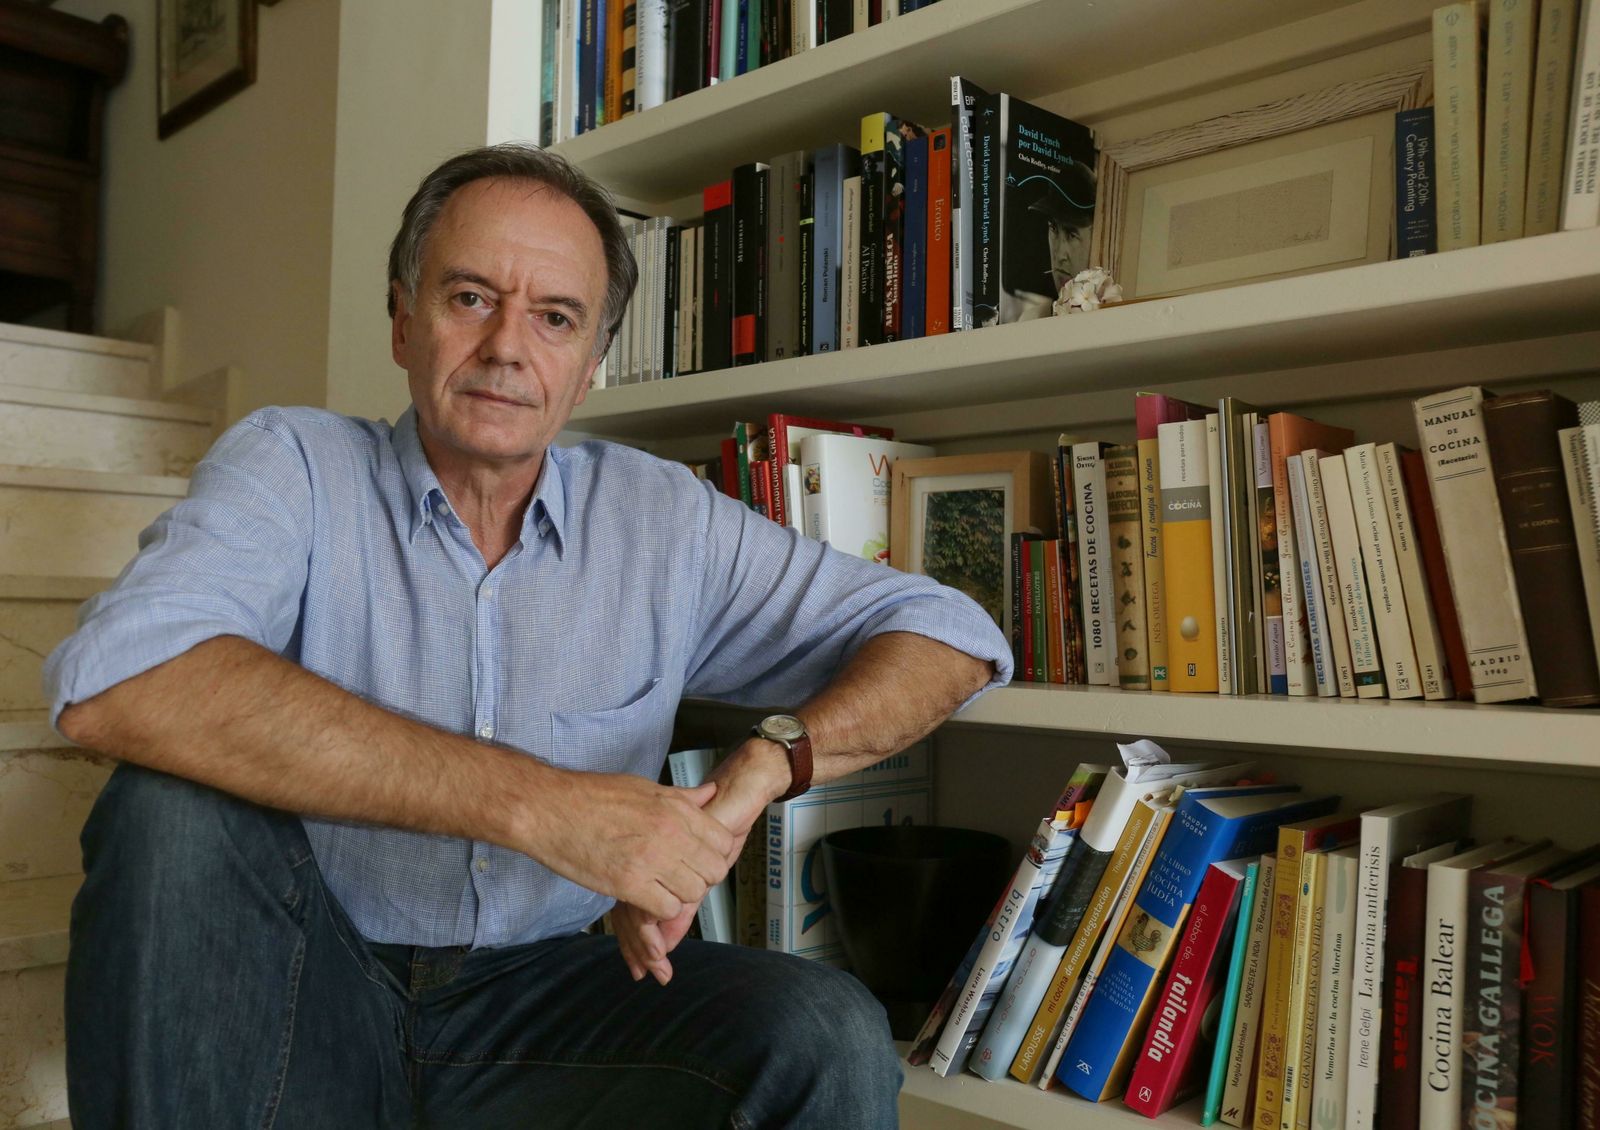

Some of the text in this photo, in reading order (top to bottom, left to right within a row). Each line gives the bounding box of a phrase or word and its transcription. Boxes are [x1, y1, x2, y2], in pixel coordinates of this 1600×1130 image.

[1584, 71, 1596, 91] LOS
[1583, 96, 1592, 107] DE
[983, 135, 991, 156] David
[1018, 124, 1060, 149] David Lynch
[1577, 113, 1590, 147] SOCIAL
[1018, 139, 1074, 165] por David Lynch
[1018, 153, 1030, 163] Chris
[981, 158, 991, 181] Lynch
[1403, 133, 1417, 212] Century Painting
[1417, 160, 1429, 180] and
[1572, 151, 1586, 195] HISTORIA
[1586, 148, 1600, 194] PINTORES
[981, 183, 990, 195] por
[983, 198, 991, 219] David
[1449, 199, 1462, 240] HISTORIA
[981, 221, 991, 244] Lynch
[822, 247, 830, 303] Roman Polanski
[861, 245, 870, 294] Al Pacino
[869, 242, 877, 289] Conversaciones
[884, 233, 894, 287] MUÑECA
[1424, 408, 1477, 427] MANUAL
[768, 427, 777, 455] CHECA
[1429, 436, 1481, 454] COCINA
[1308, 455, 1317, 479] Simone
[1438, 452, 1478, 467] (Recetario)
[772, 456, 781, 512] TRADICIONAL
[1144, 457, 1158, 524] consejos de cocina
[1312, 478, 1321, 499] Ortega
[1168, 500, 1202, 511] COCINA
[1386, 465, 1408, 552] Ortega El libro de las carnes
[1319, 518, 1327, 540] Ortega
[1322, 541, 1329, 549] El
[1362, 471, 1391, 614] Victoria Llamas Cocina para personas ocupadas
[1083, 482, 1103, 649] 1080 RECETAS DE COCINA
[1323, 549, 1331, 565] libro
[1326, 565, 1332, 574] de
[1151, 580, 1161, 644] INÉS ORTEGA
[1327, 584, 1337, 606] potajes
[1272, 623, 1280, 645] Zapata
[1287, 620, 1295, 649] Cocina
[1303, 560, 1326, 685] RECETAS ALMERIENSES
[1345, 583, 1362, 654] 7207 Lourdes March
[1359, 606, 1372, 659] libro paella
[1059, 785, 1075, 808] COME
[1180, 809, 1208, 832] CLAUDIA
[1181, 819, 1203, 838] RODEN
[769, 815, 782, 890] CEVICHE
[1159, 850, 1193, 877] EL LIBRO
[1150, 869, 1185, 899] COCINA
[1159, 864, 1181, 883] DE LA
[1146, 882, 1175, 908] JUDÍA
[991, 888, 1025, 943] bistro
[1178, 904, 1209, 968] el sabor de...
[1019, 849, 1128, 1072] LAROUSSE mi cocina de menús degustación Thierry
[1357, 845, 1381, 1069] Irene Gelpí La cocina anticrisis
[1477, 885, 1505, 1028] GALLEGA
[1232, 866, 1273, 1088] Manjula Balakrishnan SABORES INDIA 76 Recetas de Cocina
[954, 966, 986, 1027] Laura Washburn
[1054, 969, 1096, 1050] Cocina oriental
[1302, 907, 1323, 1089] GRANDES RECETAS CON FIDEOS
[1325, 933, 1343, 1082] Memorias de la cocina Murciana
[1392, 955, 1419, 1071] Tapas
[1427, 918, 1456, 1093] Cocina Balear
[1148, 972, 1193, 1062] tailandia
[1527, 993, 1558, 1070] WOK
